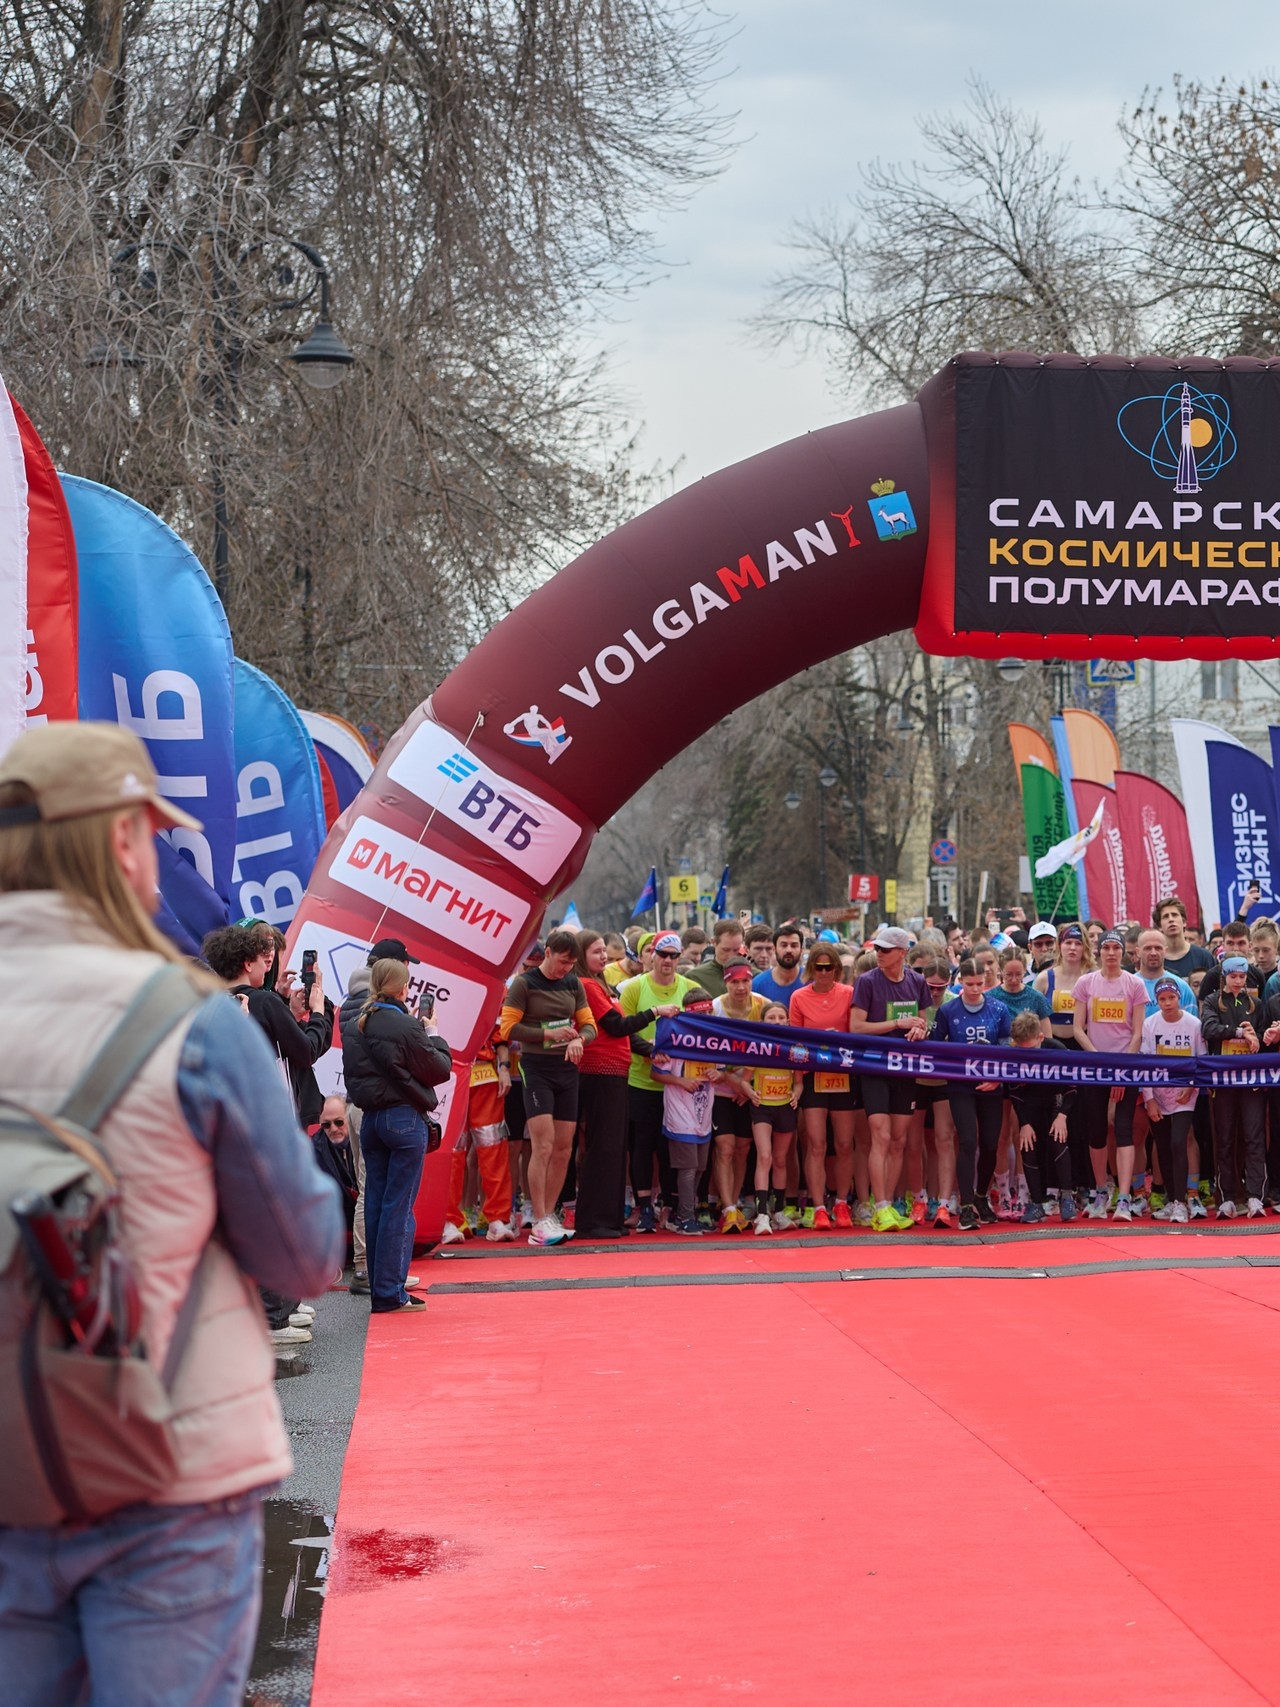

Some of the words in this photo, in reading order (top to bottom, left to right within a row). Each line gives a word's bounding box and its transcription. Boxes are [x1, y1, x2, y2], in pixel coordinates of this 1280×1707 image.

[558, 519, 839, 708] VOLGAMAN
[458, 779, 541, 851] ВТБ
[1231, 792, 1253, 897] БИЗНЕС
[679, 879, 688, 892] 6
[859, 877, 871, 891] 5
[1100, 1007, 1124, 1018] 3620
[671, 1033, 773, 1056] VOLGAMAN
[887, 1051, 936, 1074] ВТБ
[766, 1085, 789, 1095] 3422
[825, 1077, 845, 1088] 3731
